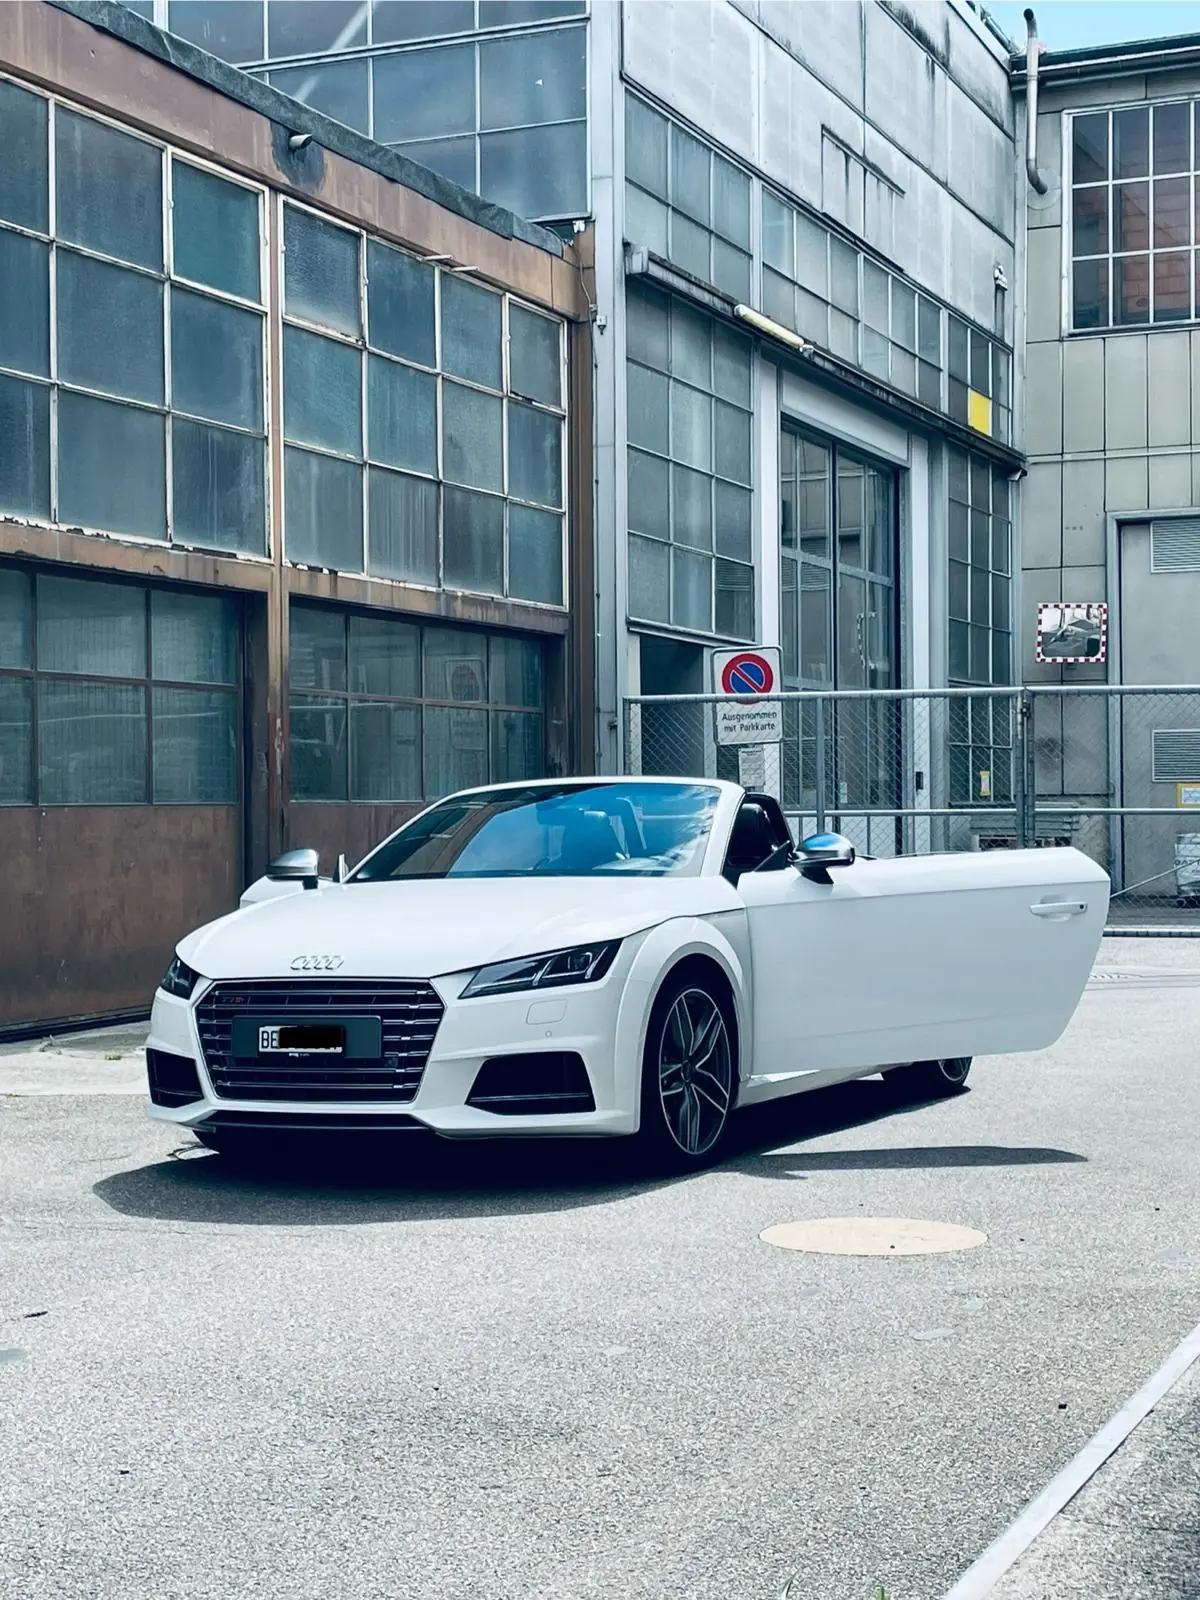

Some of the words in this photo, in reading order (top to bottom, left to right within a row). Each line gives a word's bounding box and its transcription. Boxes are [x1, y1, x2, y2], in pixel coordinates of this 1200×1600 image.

[722, 712, 777, 722] Ausgenommen
[740, 722, 776, 731] Parkkarte
[261, 1030, 280, 1049] BE
